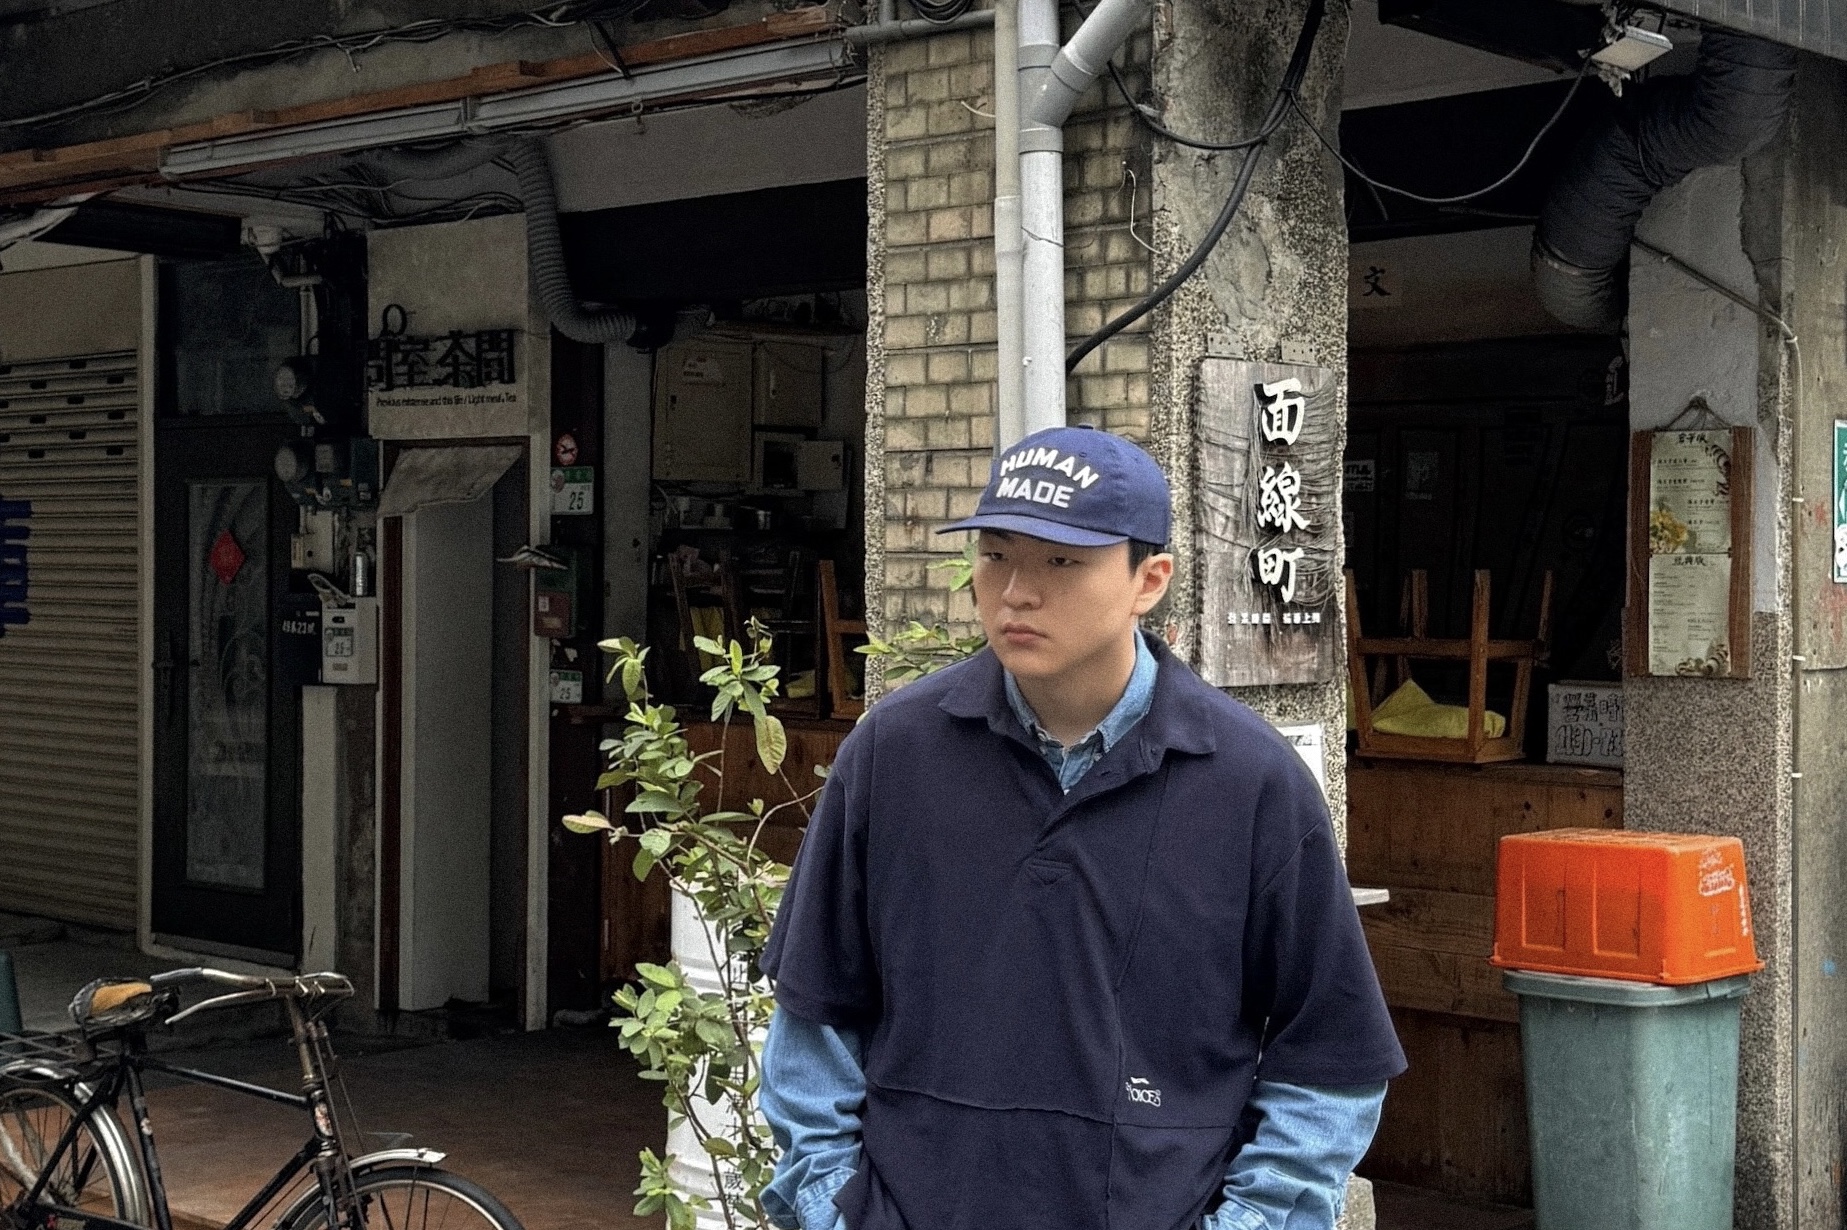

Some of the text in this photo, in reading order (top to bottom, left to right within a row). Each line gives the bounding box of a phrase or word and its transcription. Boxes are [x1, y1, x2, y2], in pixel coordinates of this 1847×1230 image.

[1362, 265, 1391, 297] 文
[999, 446, 1100, 489] HUMAN
[568, 491, 585, 511] 25
[995, 476, 1076, 509] MADE
[1256, 377, 1311, 604] 面線町
